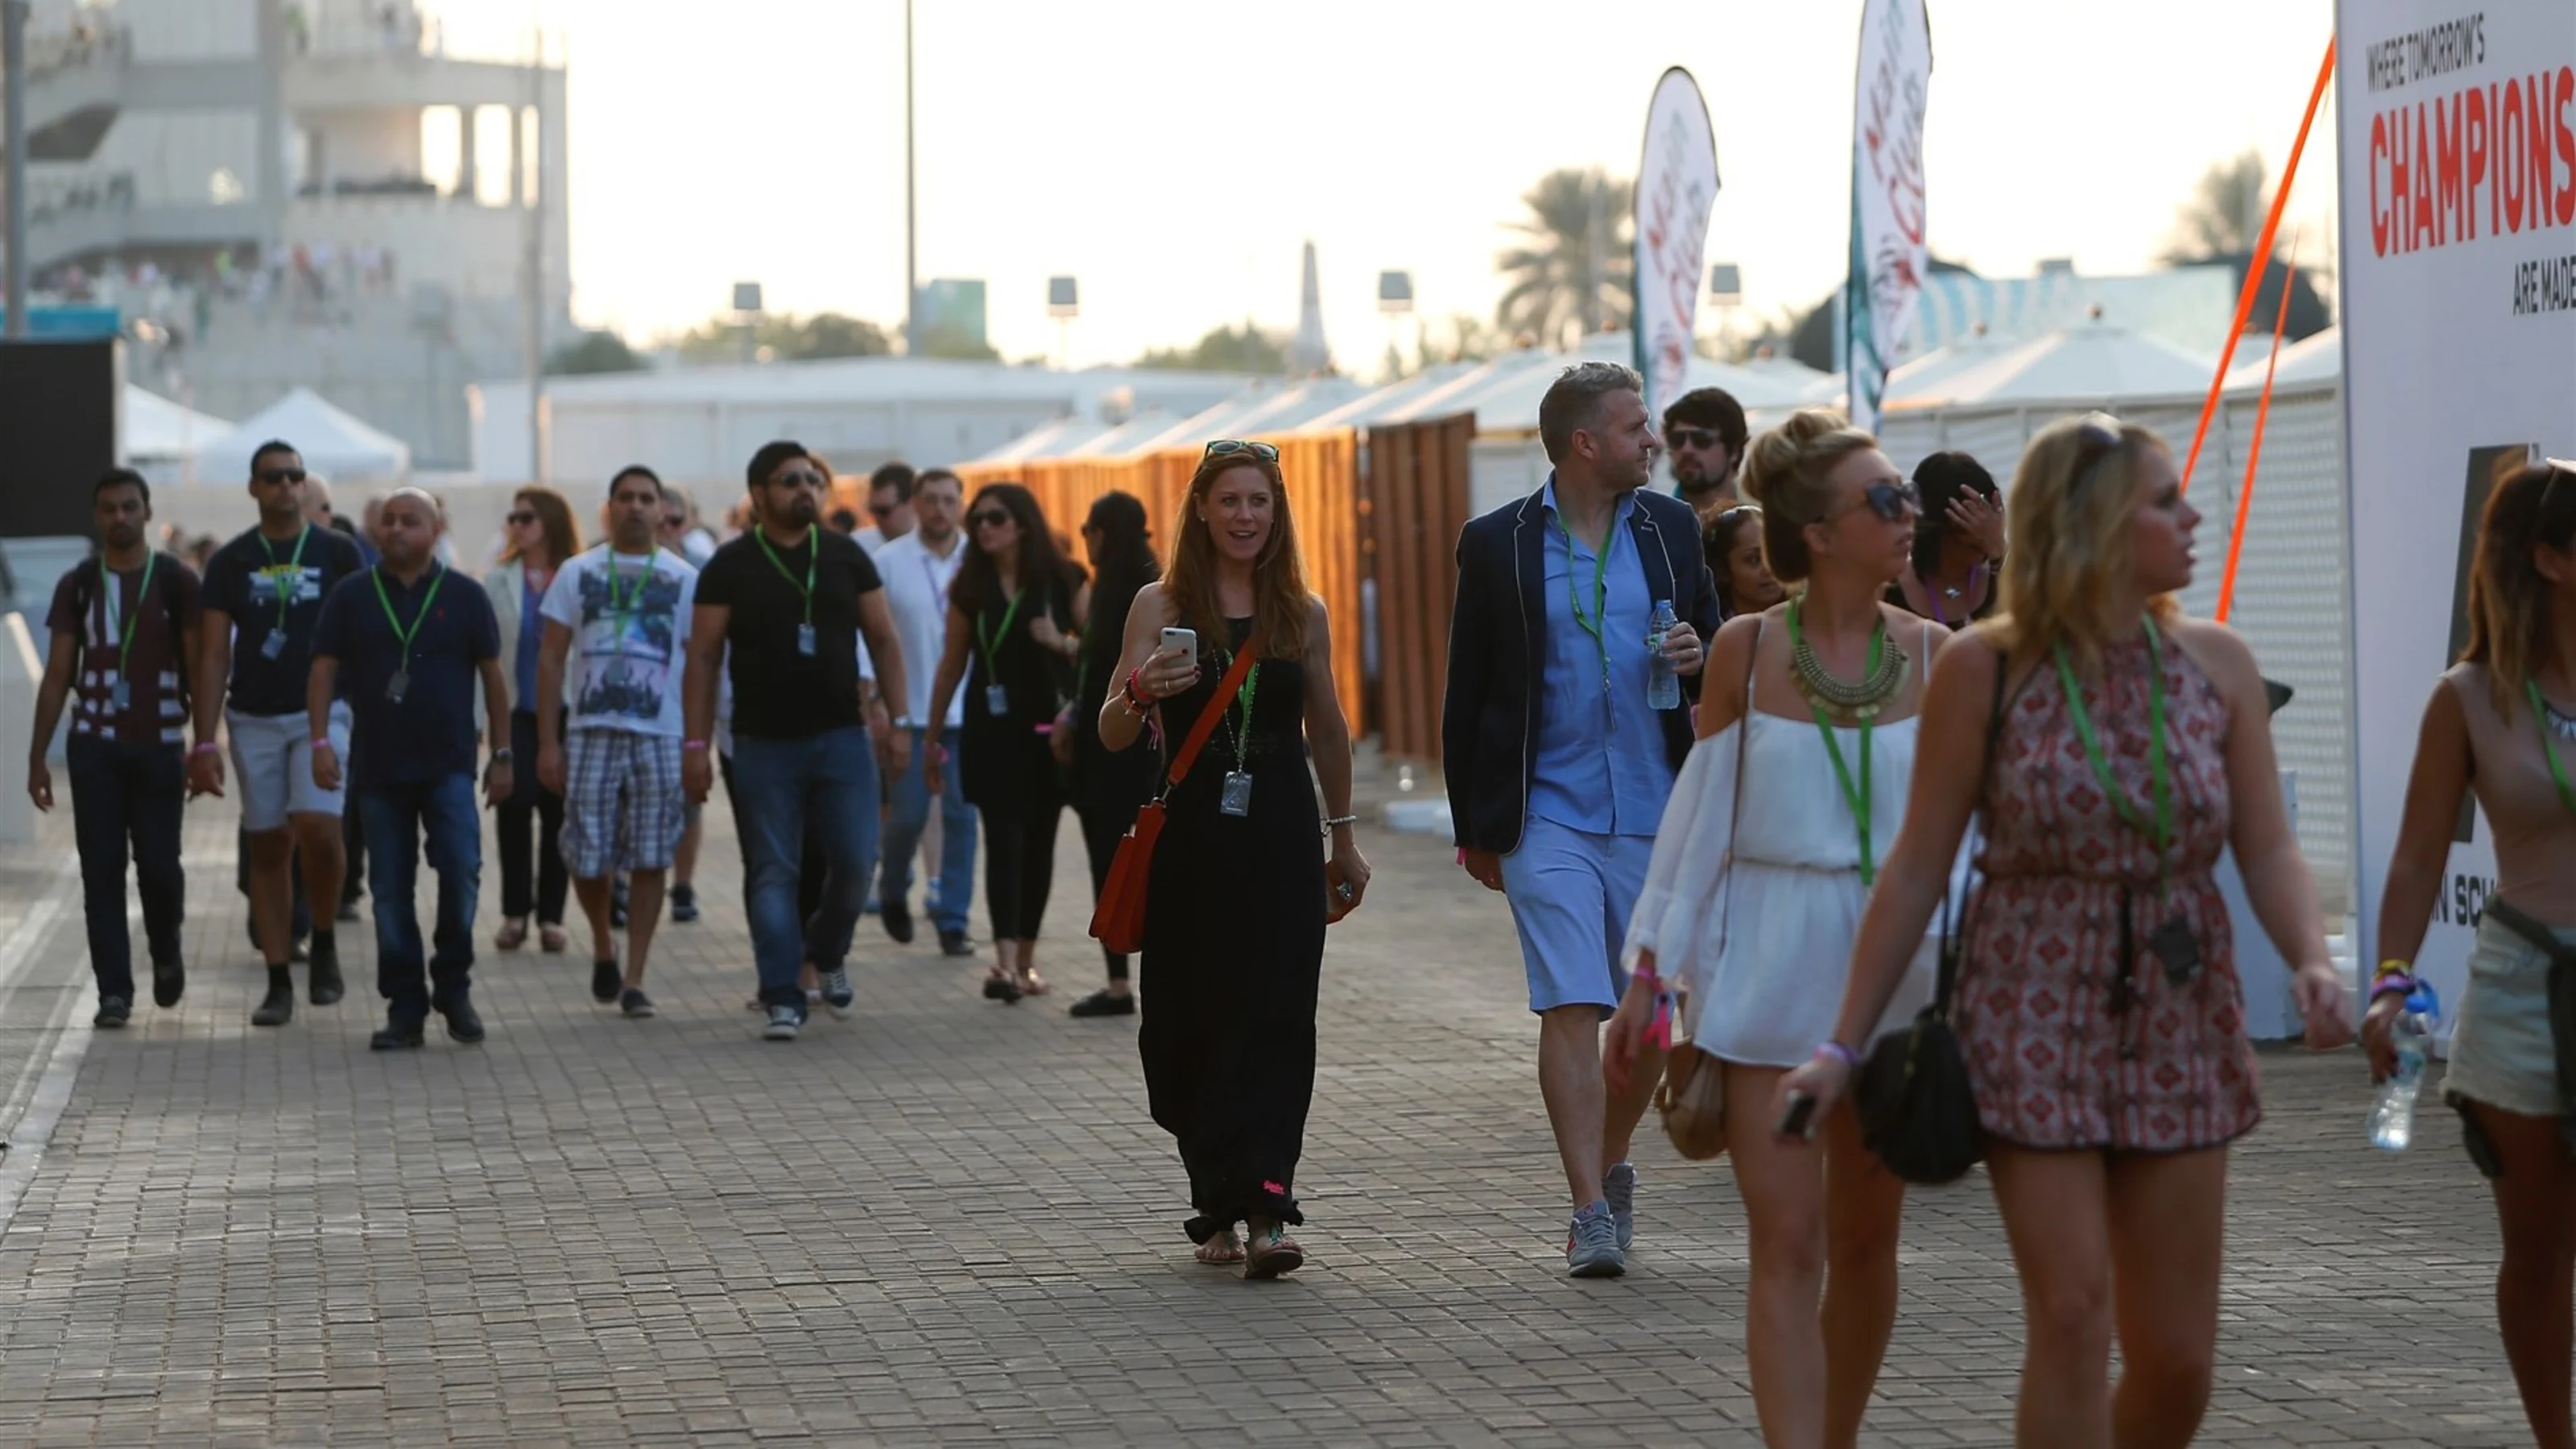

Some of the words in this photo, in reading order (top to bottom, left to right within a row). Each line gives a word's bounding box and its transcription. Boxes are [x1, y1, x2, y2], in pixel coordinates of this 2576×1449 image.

[2366, 36, 2405, 93] WHERE
[2407, 11, 2485, 82] TOMORROW'S
[2369, 65, 2576, 259] CHAMPIONS
[2513, 260, 2538, 316] ARE
[2541, 254, 2576, 312] MADE
